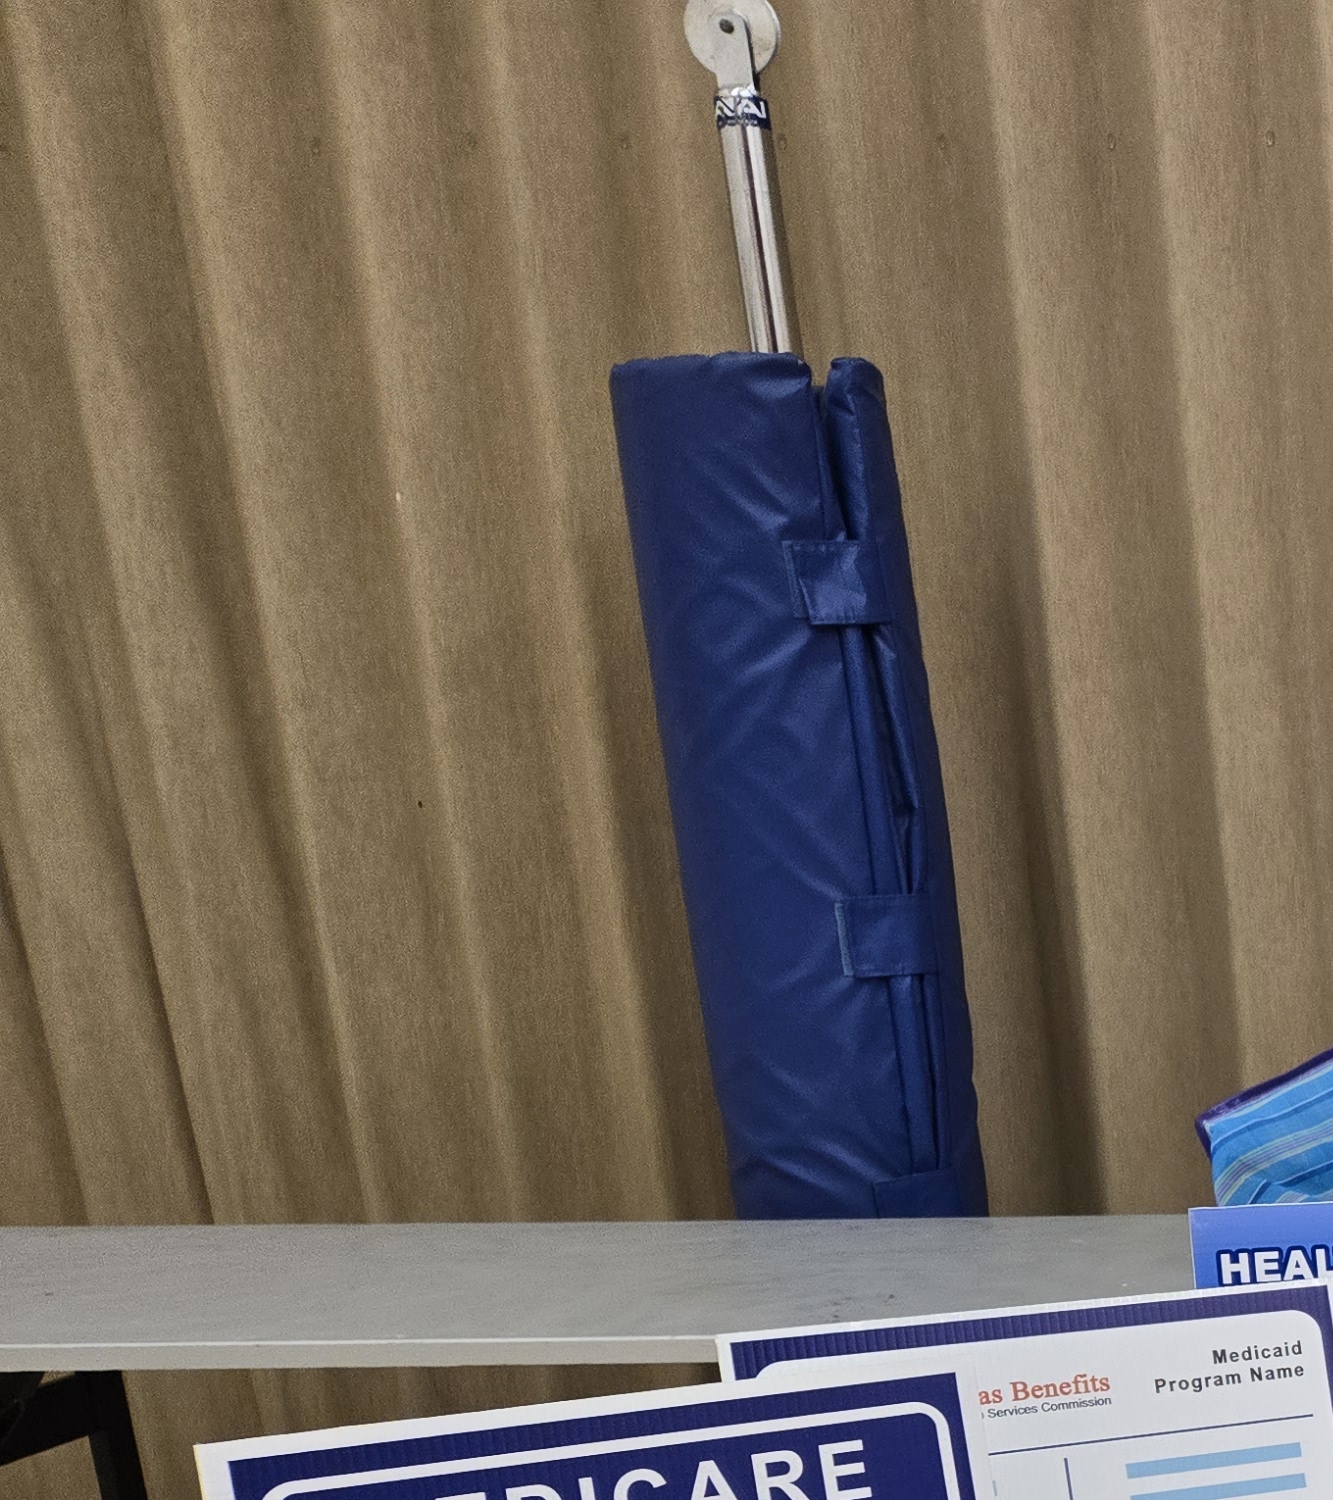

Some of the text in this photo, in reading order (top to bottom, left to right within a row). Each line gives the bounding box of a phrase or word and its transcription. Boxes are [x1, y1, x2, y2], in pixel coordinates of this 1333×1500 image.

[1212, 1340, 1303, 1365] Medicaid
[1010, 1373, 1111, 1402] Benefits
[1154, 1364, 1305, 1394] Program Name
[987, 1396, 1112, 1419] Services Commission
